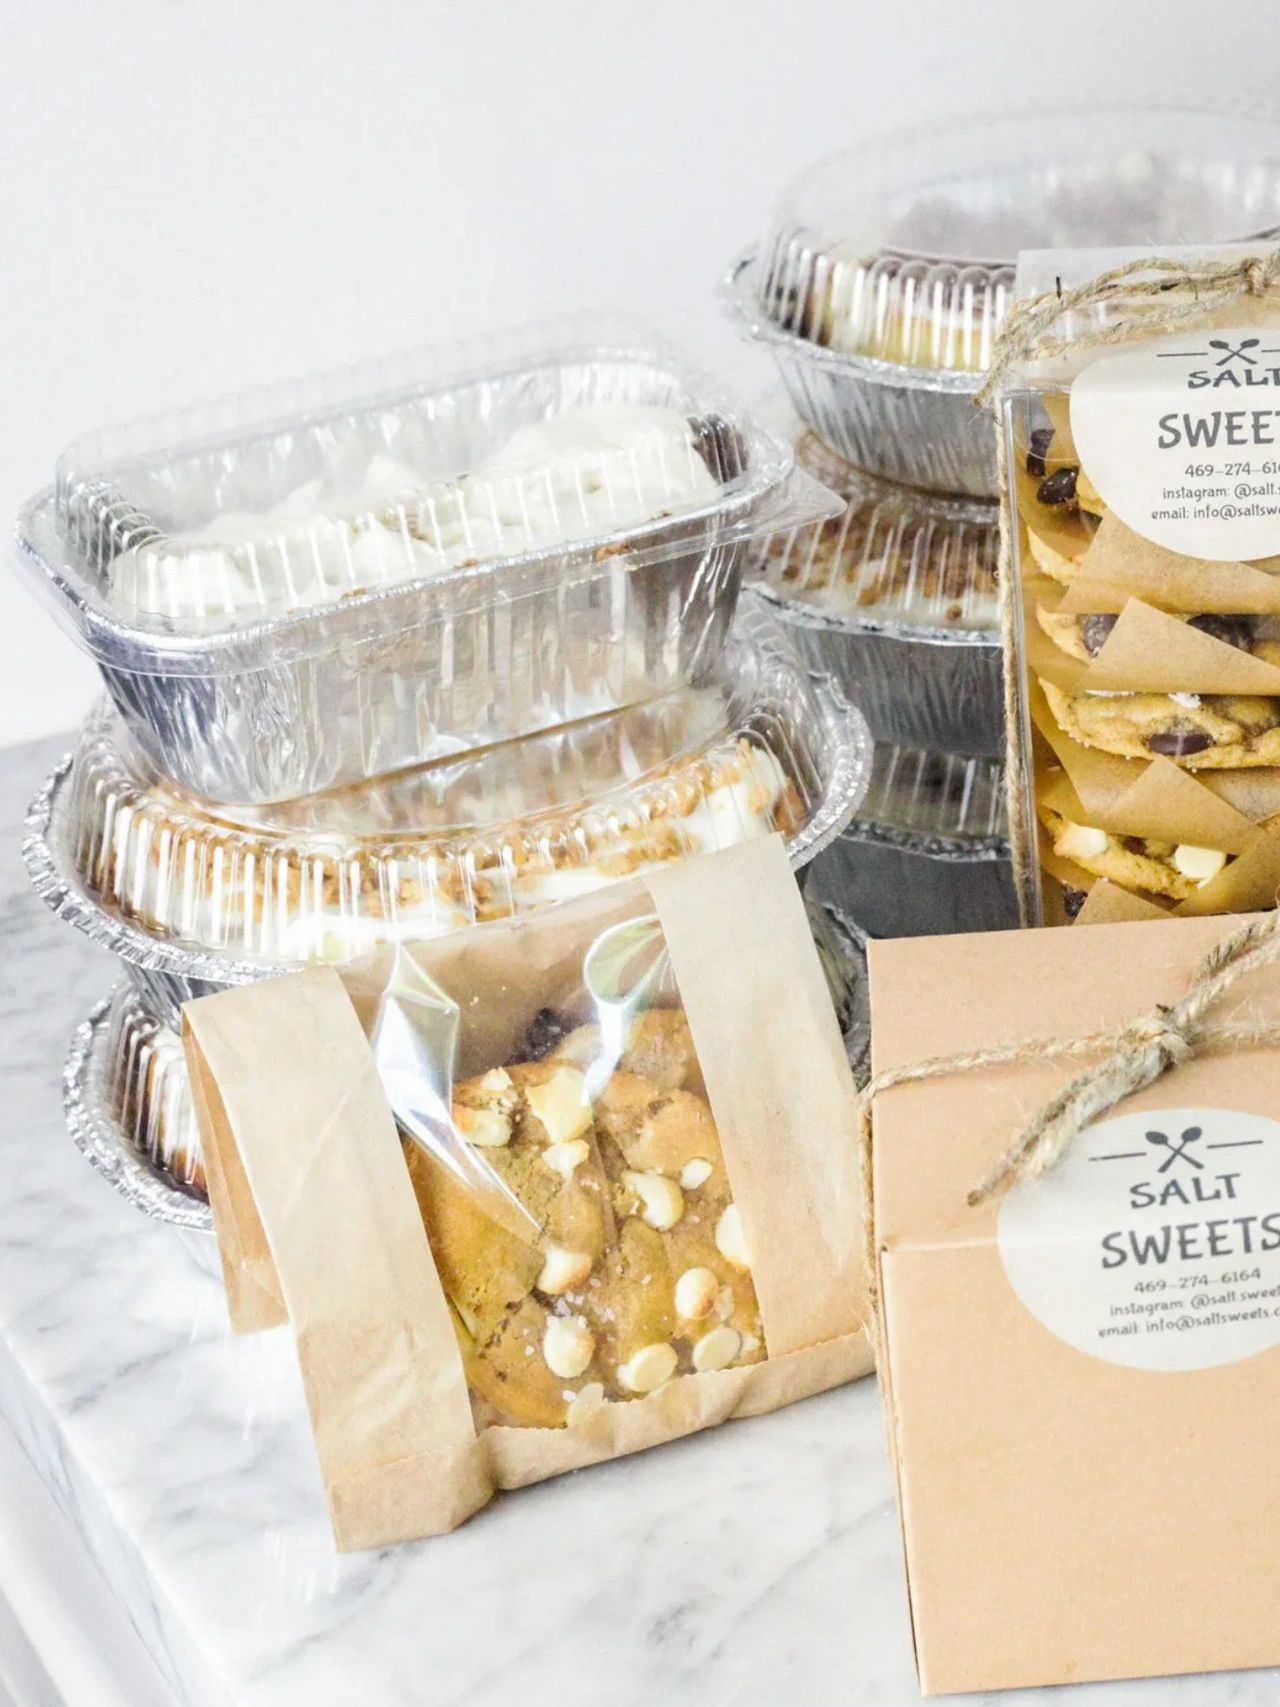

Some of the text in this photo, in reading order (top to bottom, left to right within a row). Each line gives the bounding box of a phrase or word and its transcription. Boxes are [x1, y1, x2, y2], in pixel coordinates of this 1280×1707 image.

[1162, 487, 1230, 502] instagram:
[1151, 506, 1189, 520] email:
[1130, 1173, 1241, 1209] SALT
[1134, 1268, 1262, 1294] 469-274-6164
